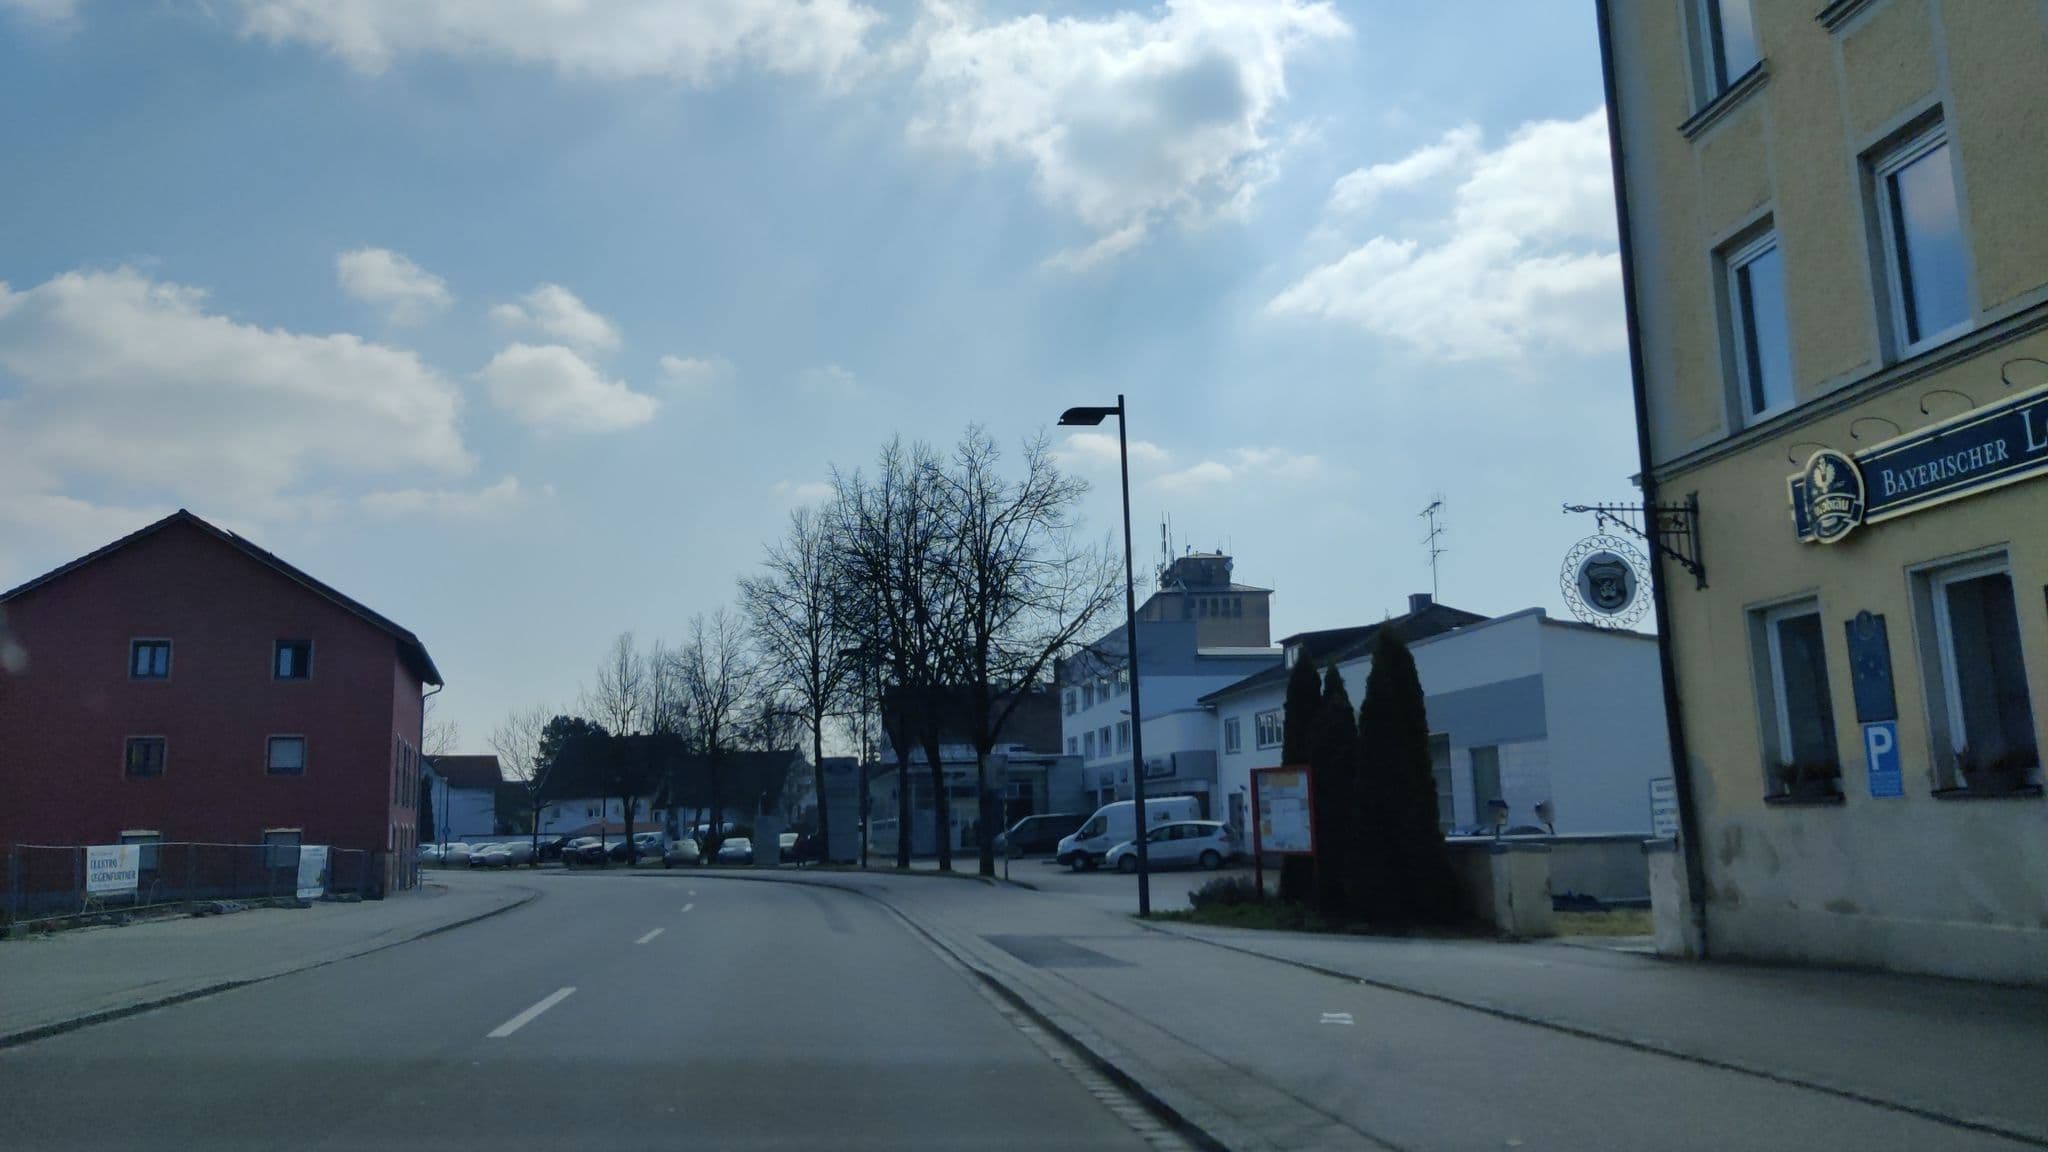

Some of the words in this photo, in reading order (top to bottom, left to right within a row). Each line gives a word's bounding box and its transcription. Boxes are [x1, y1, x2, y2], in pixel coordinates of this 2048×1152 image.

[1882, 439, 2009, 497] BAYERISCHER
[2019, 409, 2048, 453] L
[1867, 726, 1893, 770] P
